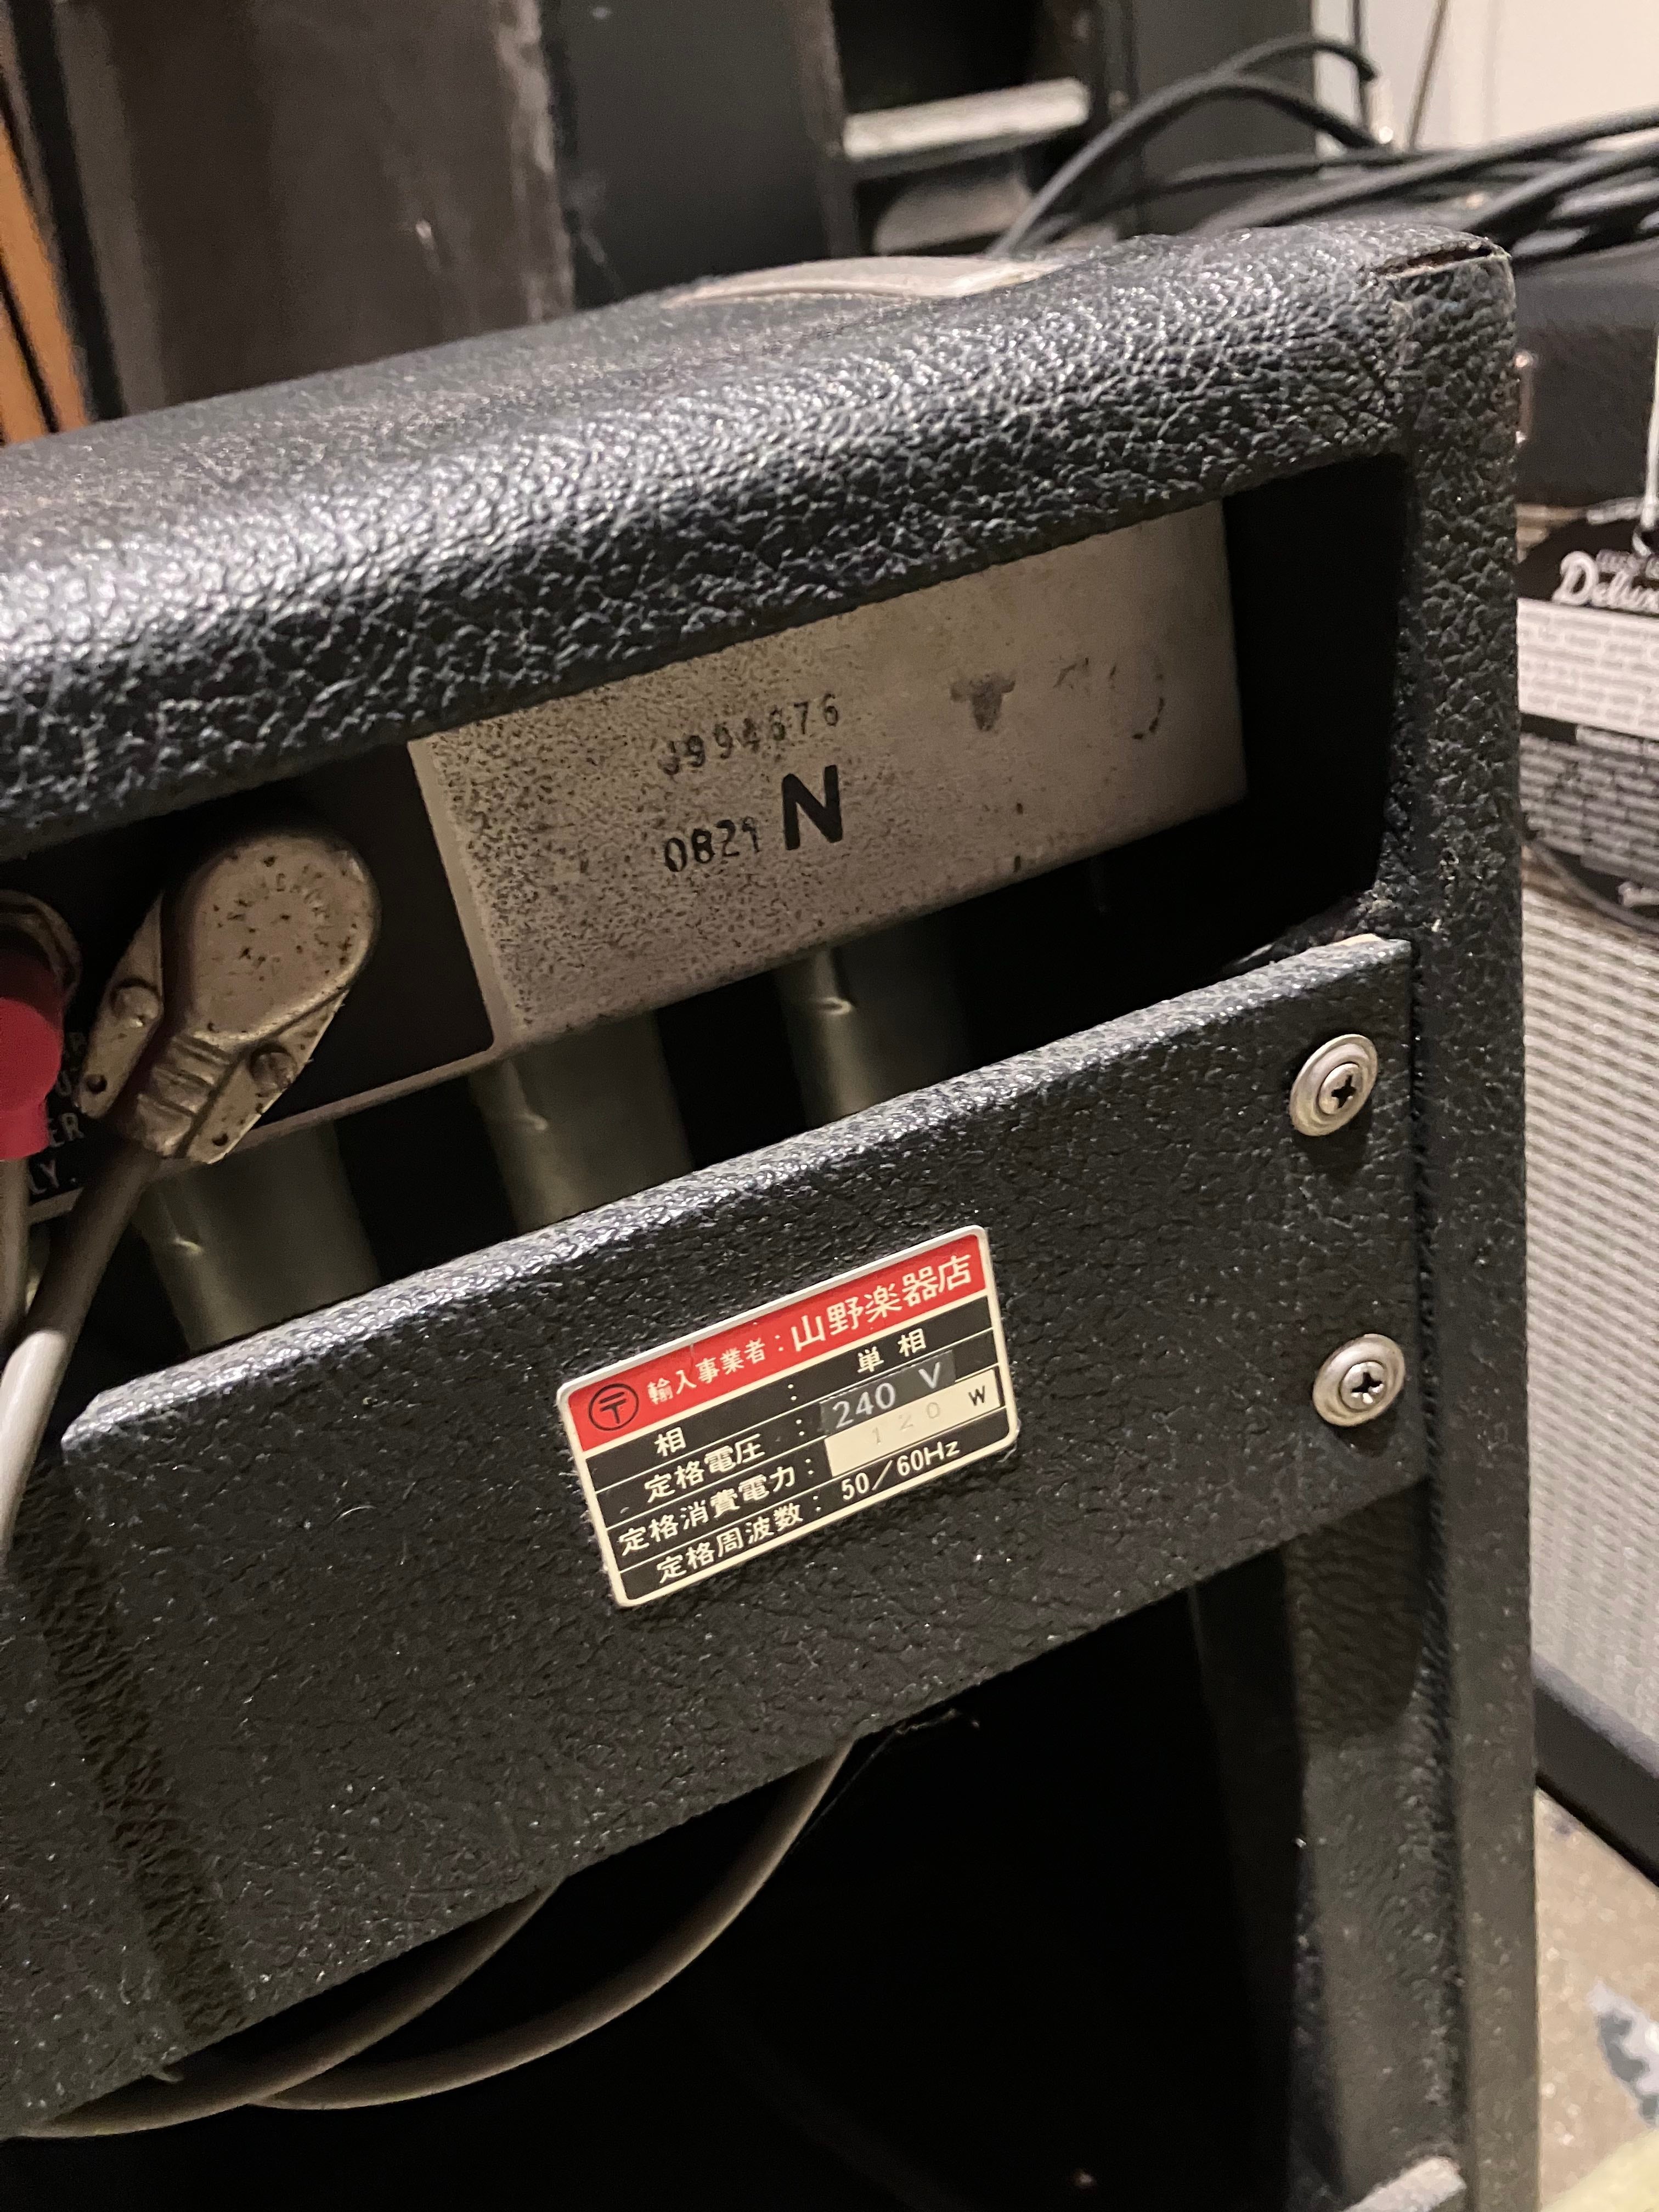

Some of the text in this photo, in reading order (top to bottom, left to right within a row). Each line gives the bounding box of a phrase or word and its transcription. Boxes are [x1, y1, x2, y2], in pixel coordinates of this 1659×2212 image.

[782, 765, 843, 850] N
[791, 1254, 972, 1352] 山野楽器店
[644, 1433, 766, 1503] 定格電圧
[832, 1381, 897, 1429] 240
[918, 1362, 941, 1390] V
[968, 1385, 986, 1407] W
[654, 1426, 686, 1457] 相
[840, 1440, 961, 1501] 50/60Hz
